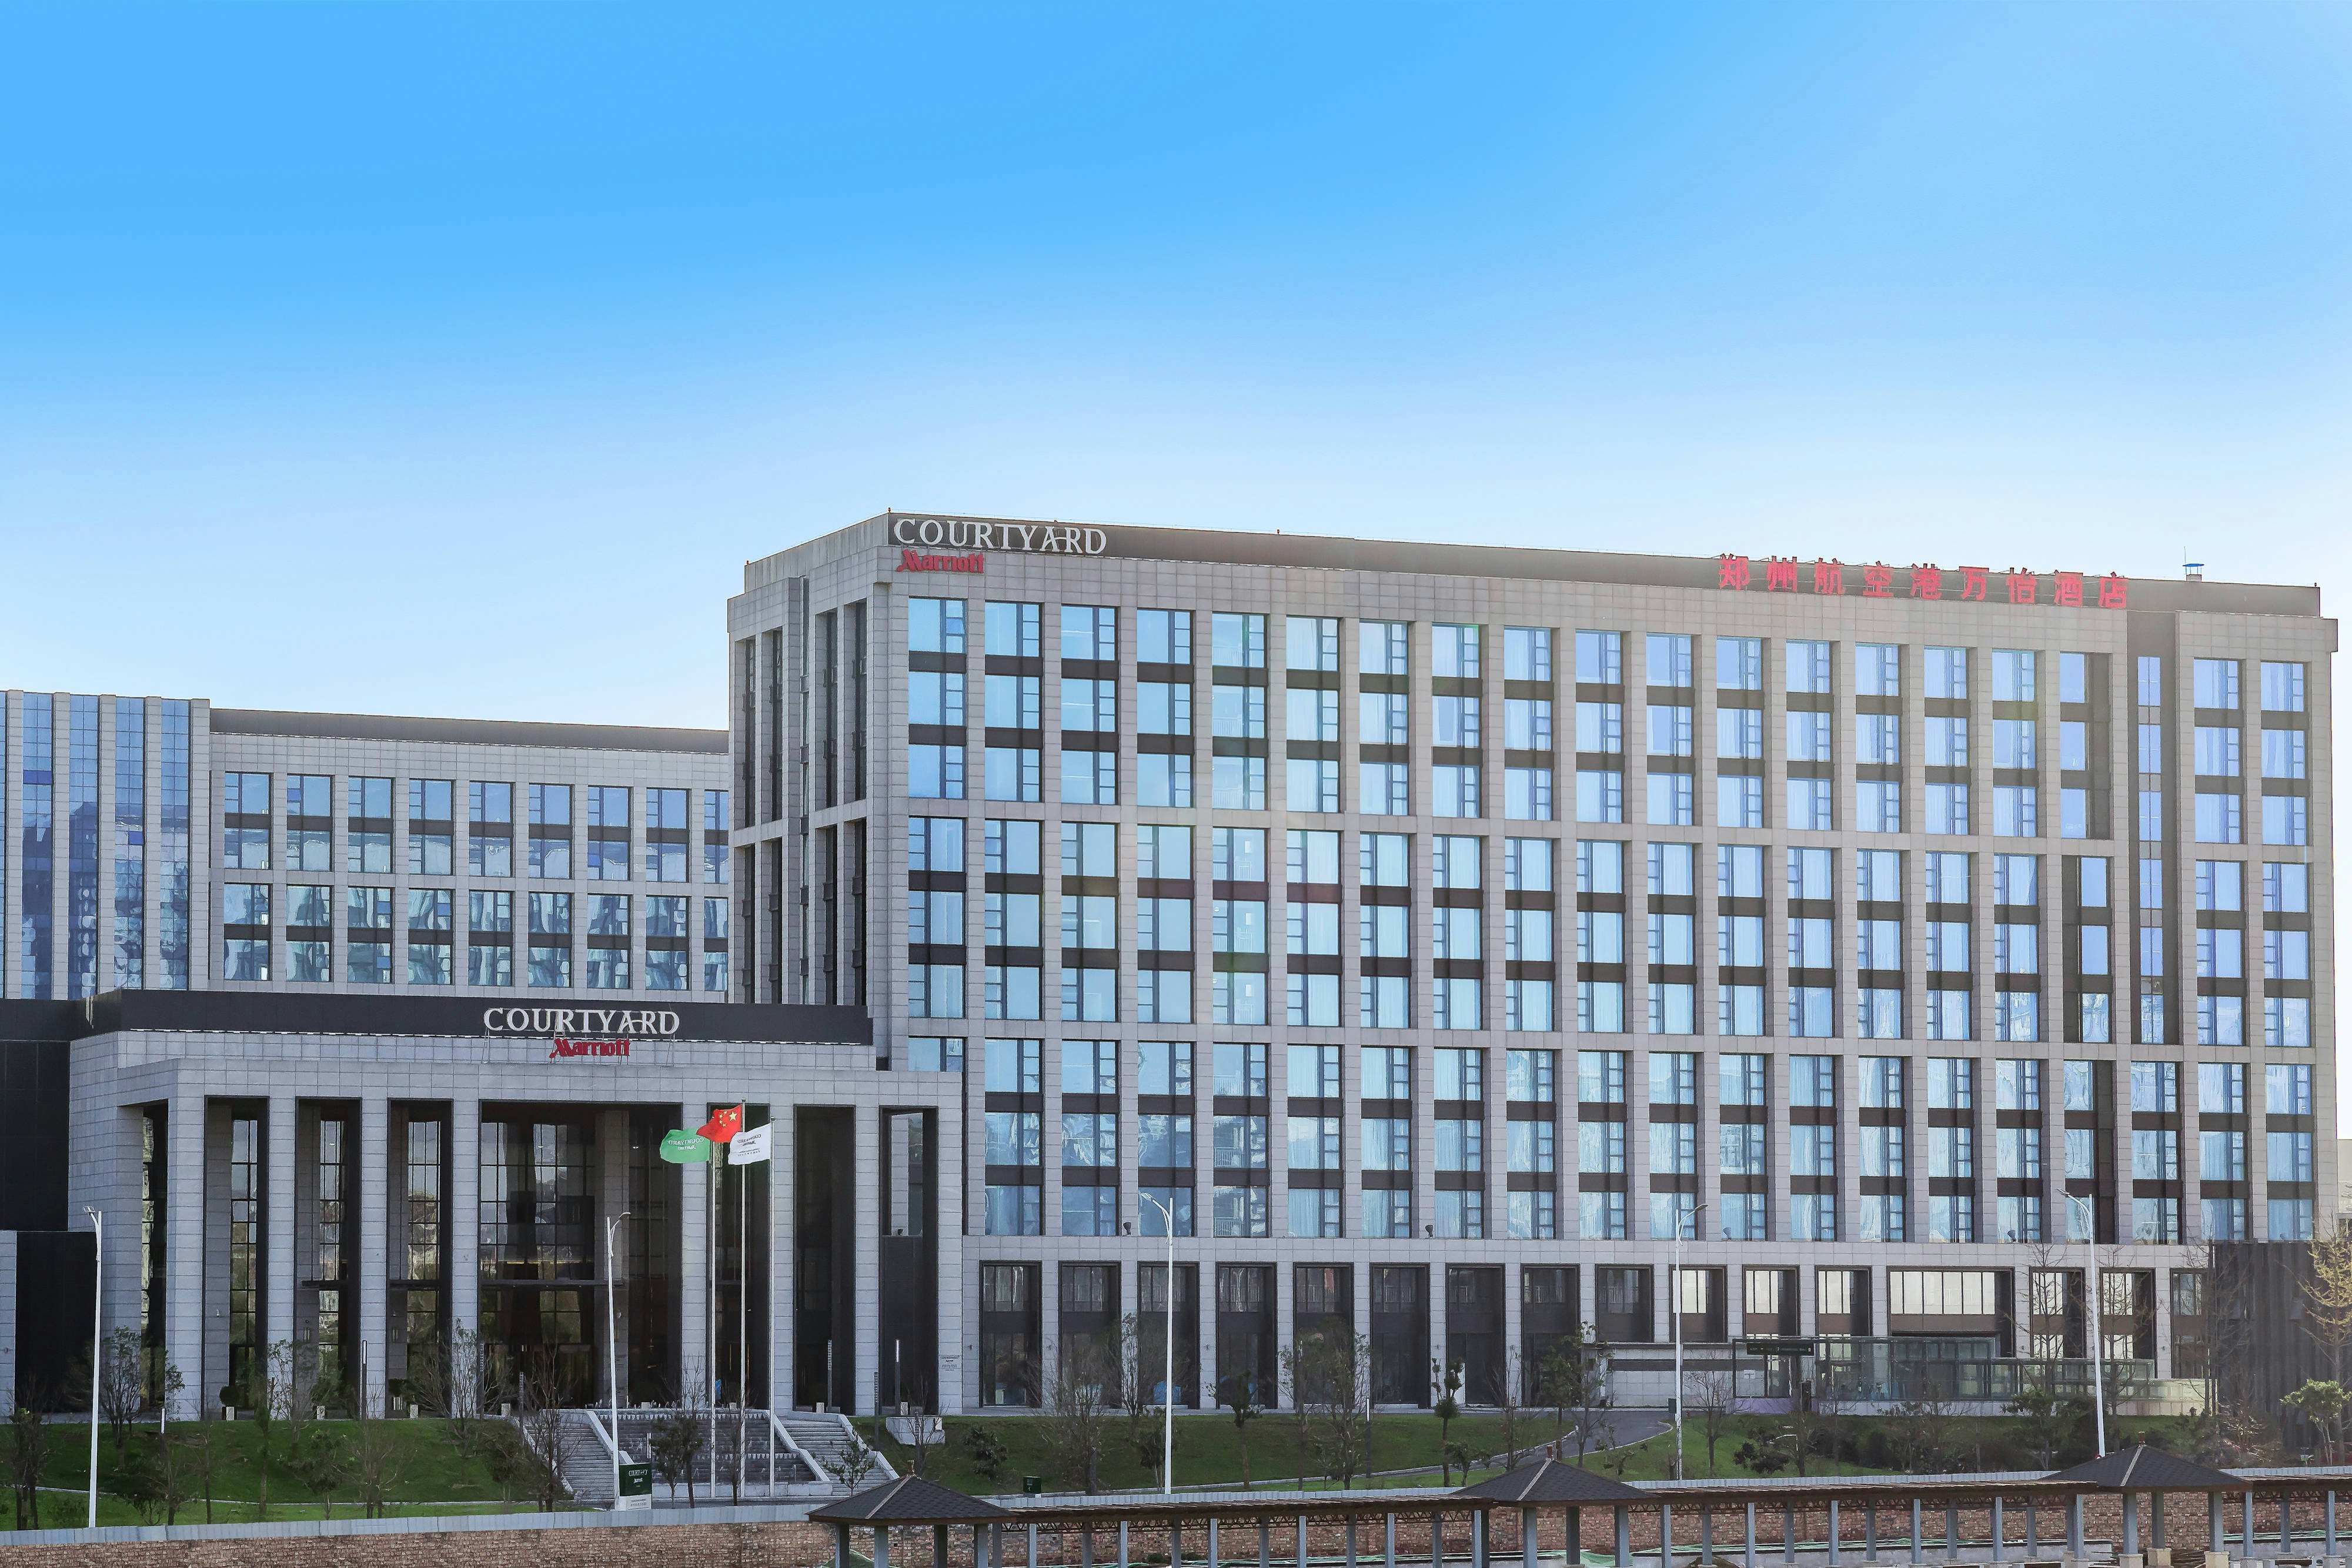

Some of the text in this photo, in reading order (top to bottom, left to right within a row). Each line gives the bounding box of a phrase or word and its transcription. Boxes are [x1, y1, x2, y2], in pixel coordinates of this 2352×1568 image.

[893, 518, 1107, 554] COURTYARD
[896, 549, 985, 574] Marriott
[1719, 553, 2129, 609] 郑州航空港万怡酒店
[483, 1007, 680, 1035] COURTYARD
[549, 1038, 631, 1058] Marriott
